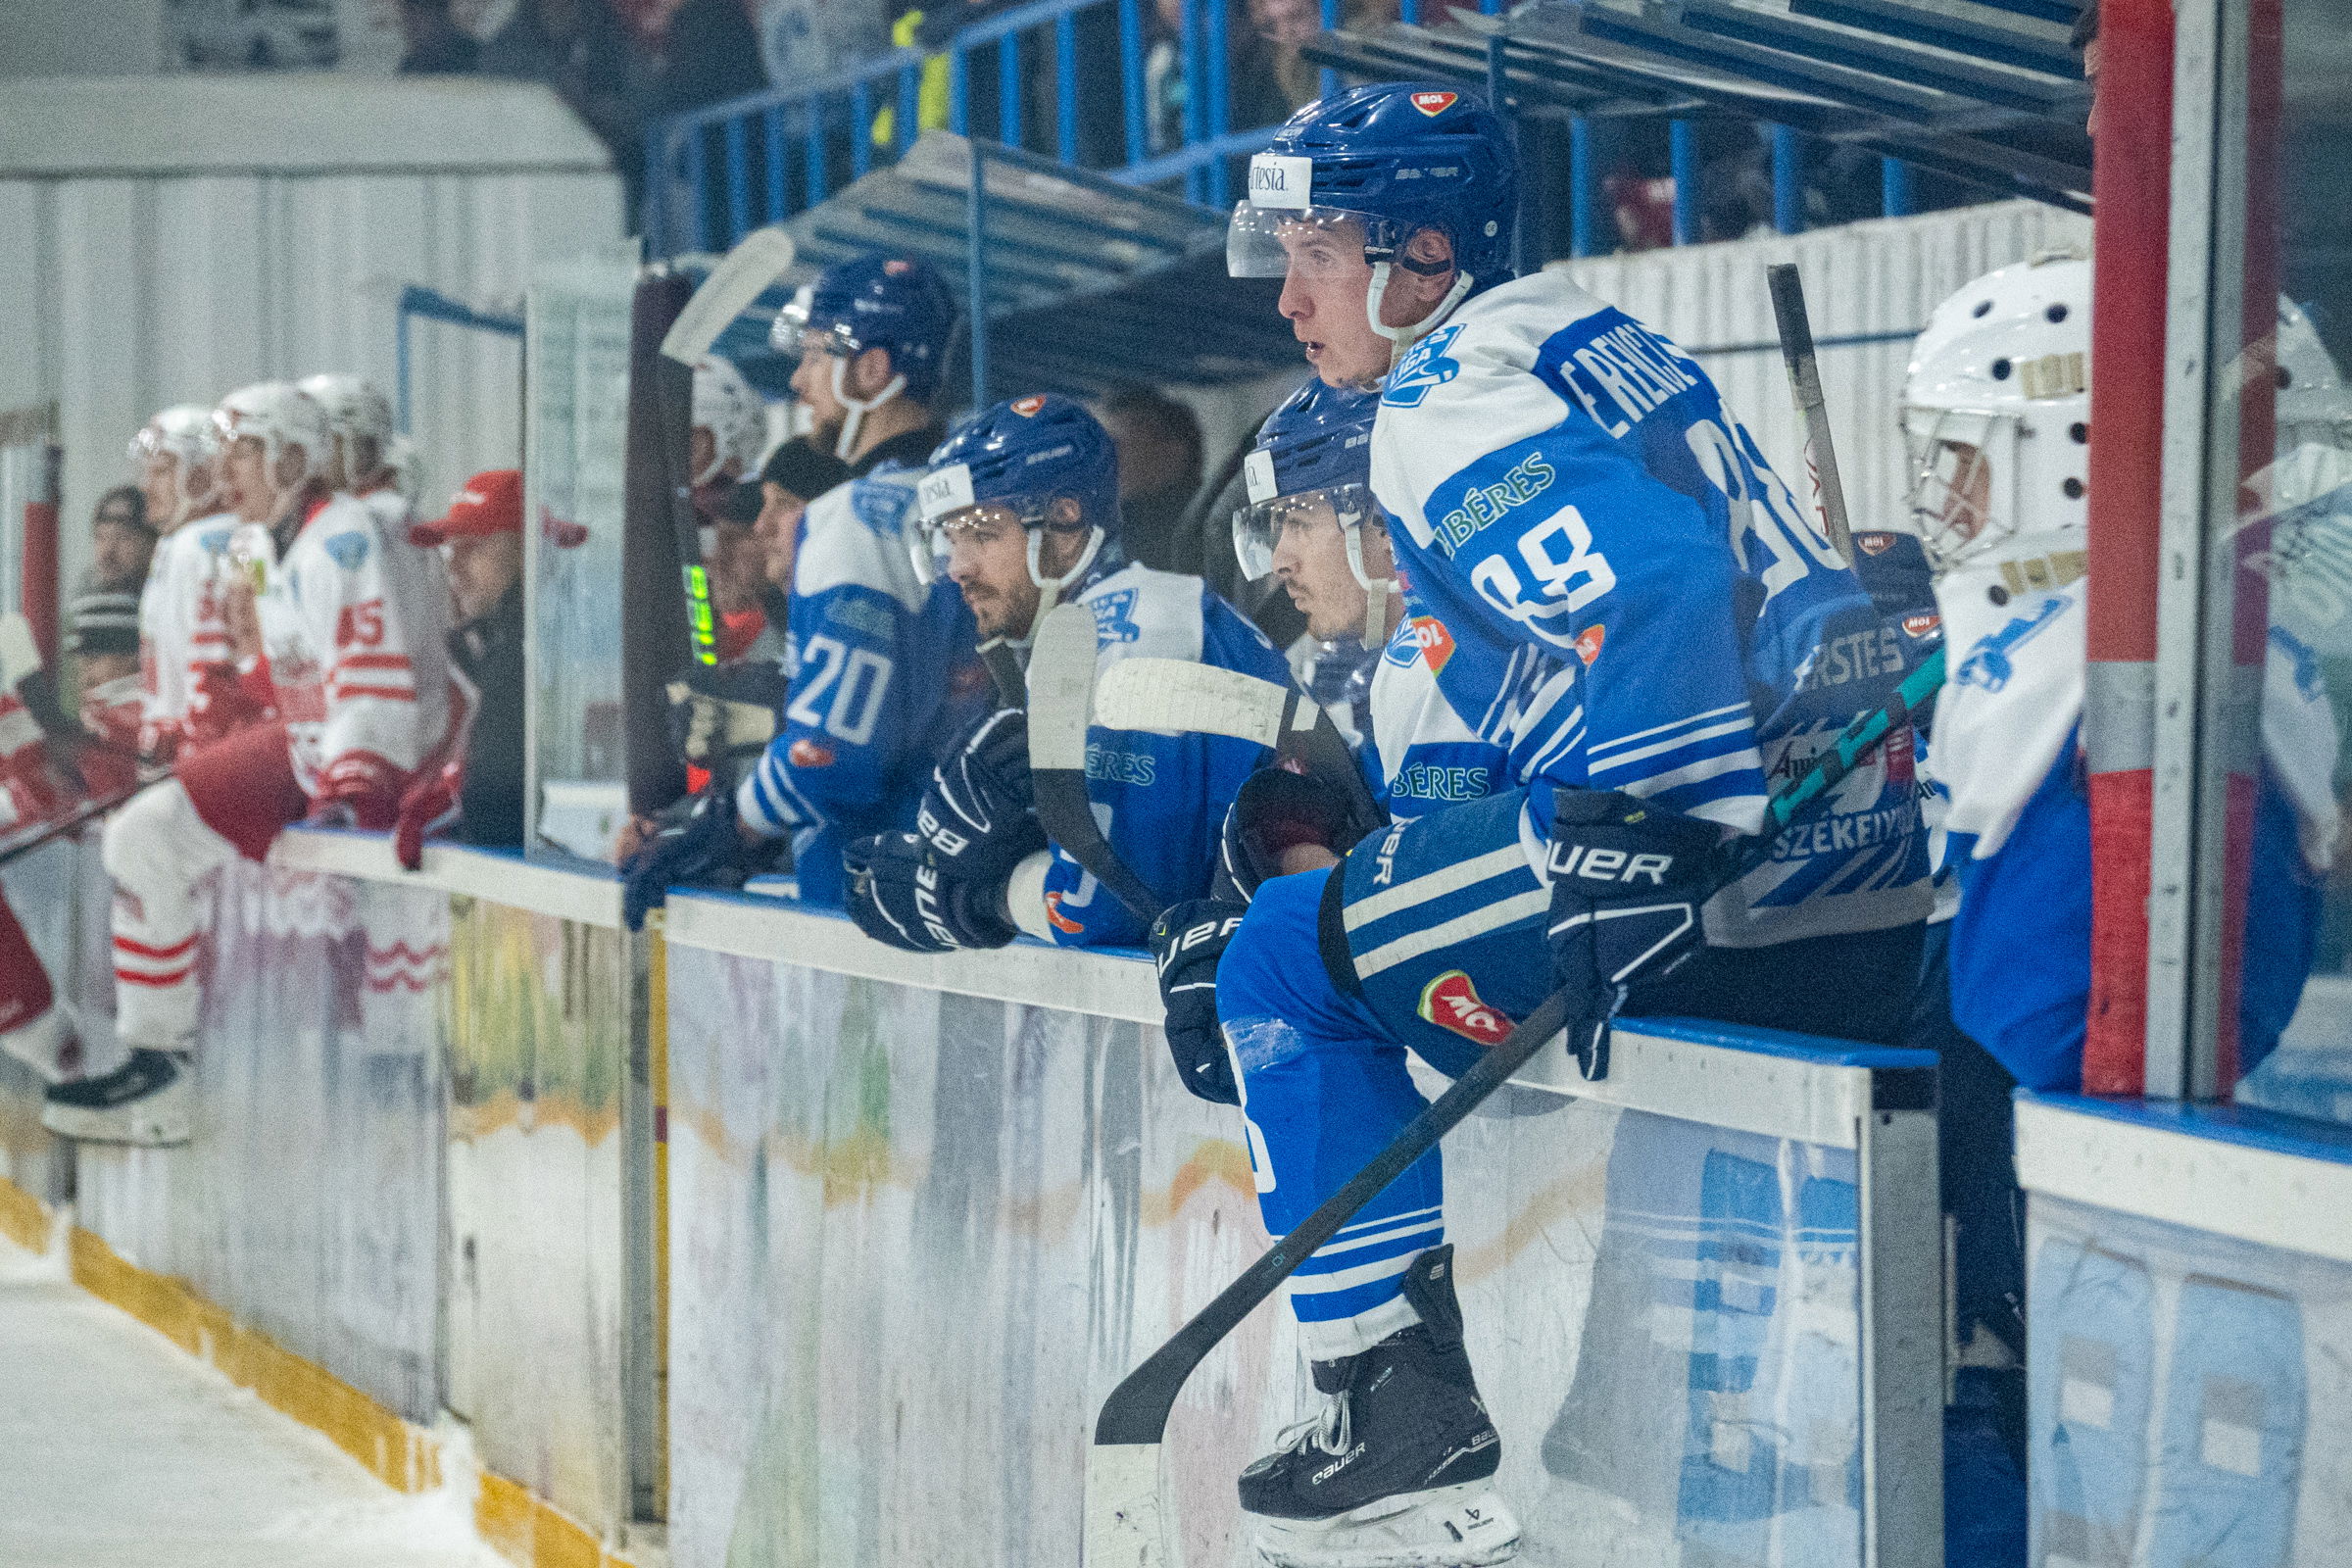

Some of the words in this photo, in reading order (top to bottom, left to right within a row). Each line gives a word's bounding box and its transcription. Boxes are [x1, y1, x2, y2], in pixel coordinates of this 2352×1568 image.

[1418, 94, 1445, 105] MOL
[1249, 162, 1285, 191] rtesia
[1417, 623, 1444, 648] OL
[787, 633, 893, 745] 20
[1086, 742, 1155, 786] ÉRES
[1392, 762, 1491, 802] BÉRES
[1441, 996, 1499, 1033] MO
